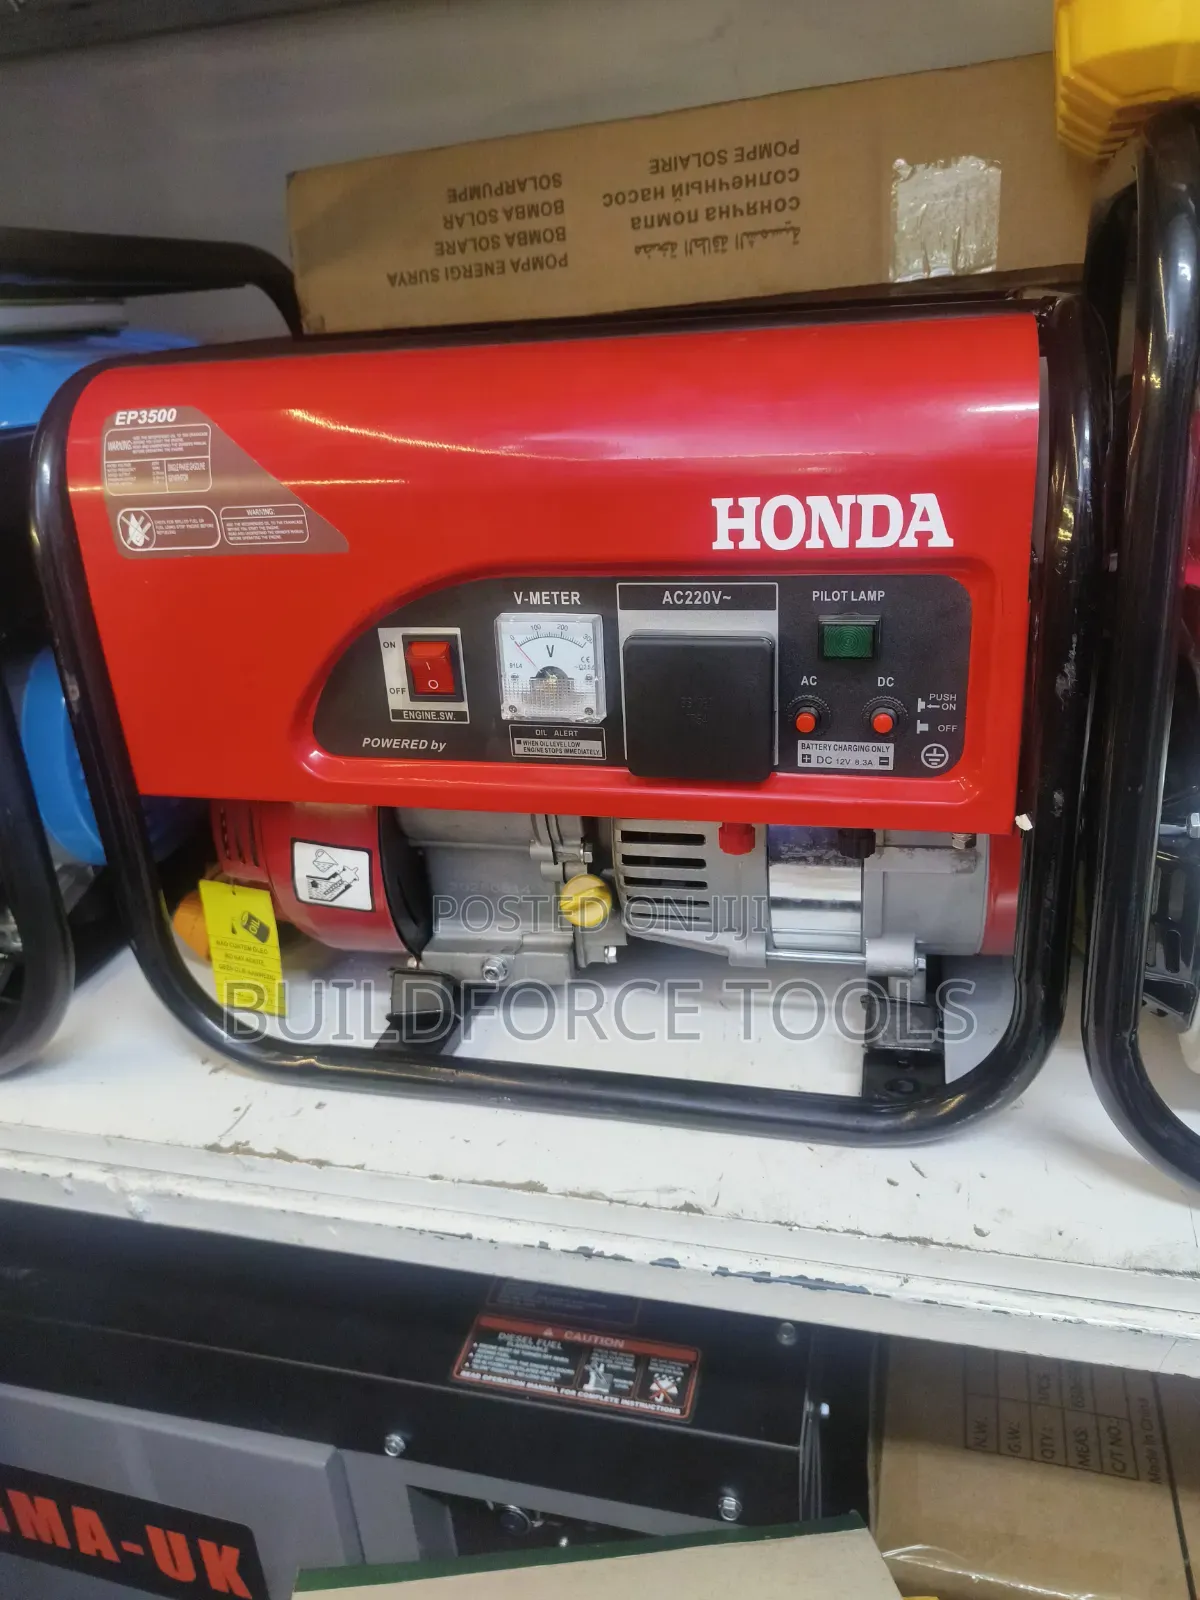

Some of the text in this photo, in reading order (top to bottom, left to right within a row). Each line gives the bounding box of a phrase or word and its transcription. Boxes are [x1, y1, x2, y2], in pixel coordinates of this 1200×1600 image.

[648, 139, 800, 175] POMPE SOLAIRE
[446, 172, 562, 204] SOLARPUMPE
[603, 167, 800, 208] солнечный насос
[442, 199, 564, 230] BOMBA SOLAR
[630, 196, 800, 232] сонячна помпа
[434, 226, 566, 257] BOMBA SOLARE
[684, 234, 729, 257] الطاقة
[735, 220, 801, 251] الشمسية
[386, 252, 568, 288] POMPA ENERGI SURYA
[115, 408, 177, 425] EP3500
[711, 492, 954, 551] HONDA
[514, 591, 582, 606] V-METER
[812, 590, 885, 602] PILOT LAMP
[530, 623, 569, 633] 100 200
[383, 641, 396, 649] ON
[546, 644, 555, 658] V
[801, 675, 895, 688] AC DC
[389, 687, 406, 696] OFF
[929, 692, 957, 701] PUSH
[941, 702, 957, 711] ON
[535, 729, 579, 738] OIL ALERT
[938, 724, 958, 733] OFF
[362, 737, 447, 753] POWERED by
[801, 743, 890, 753] BATTERY CHARGING ONLY
[816, 755, 832, 764] DC
[249, 919, 261, 934] OIL
[497, 1331, 562, 1349] DIESEL FUEL
[563, 1330, 625, 1349] CAUTION
[559, 1387, 577, 1395] FOR
[576, 1390, 620, 1404] COMPLETE
[620, 1398, 681, 1415] INSTRUCTIONS
